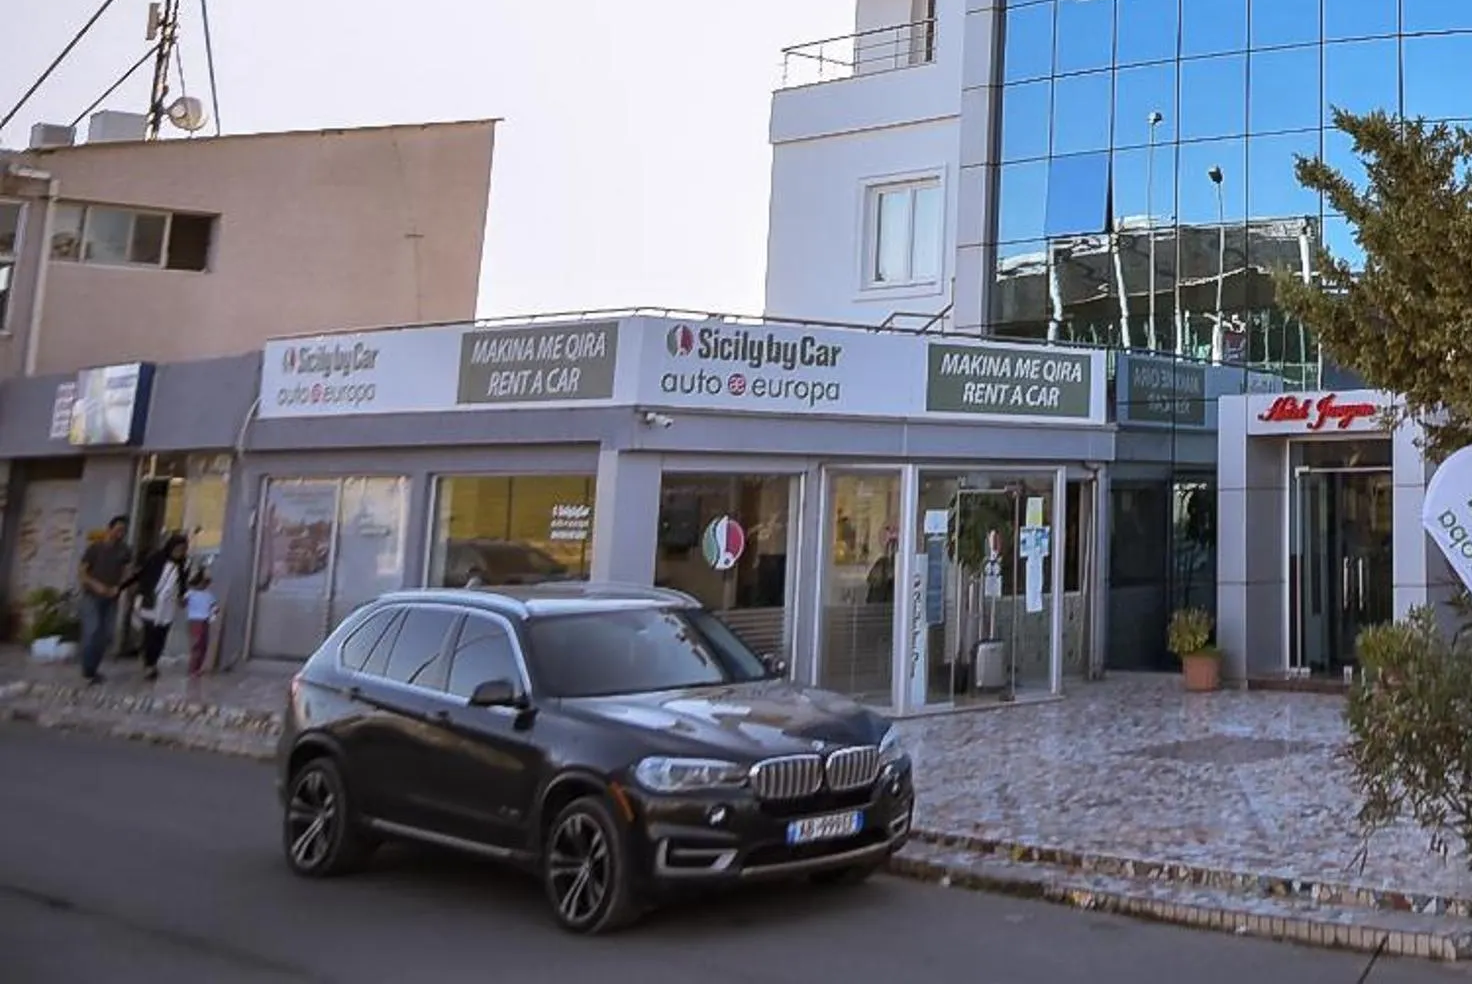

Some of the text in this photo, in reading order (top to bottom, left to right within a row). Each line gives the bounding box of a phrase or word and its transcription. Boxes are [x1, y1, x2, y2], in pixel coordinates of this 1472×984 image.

[471, 332, 606, 364] MAKINA ME QIRA
[487, 367, 582, 396] RENT A CAR
[940, 353, 1082, 383] MAKINA ME QIRA
[660, 369, 722, 395] auto
[752, 377, 840, 406] europa
[963, 381, 1060, 408] RENT A CAR
